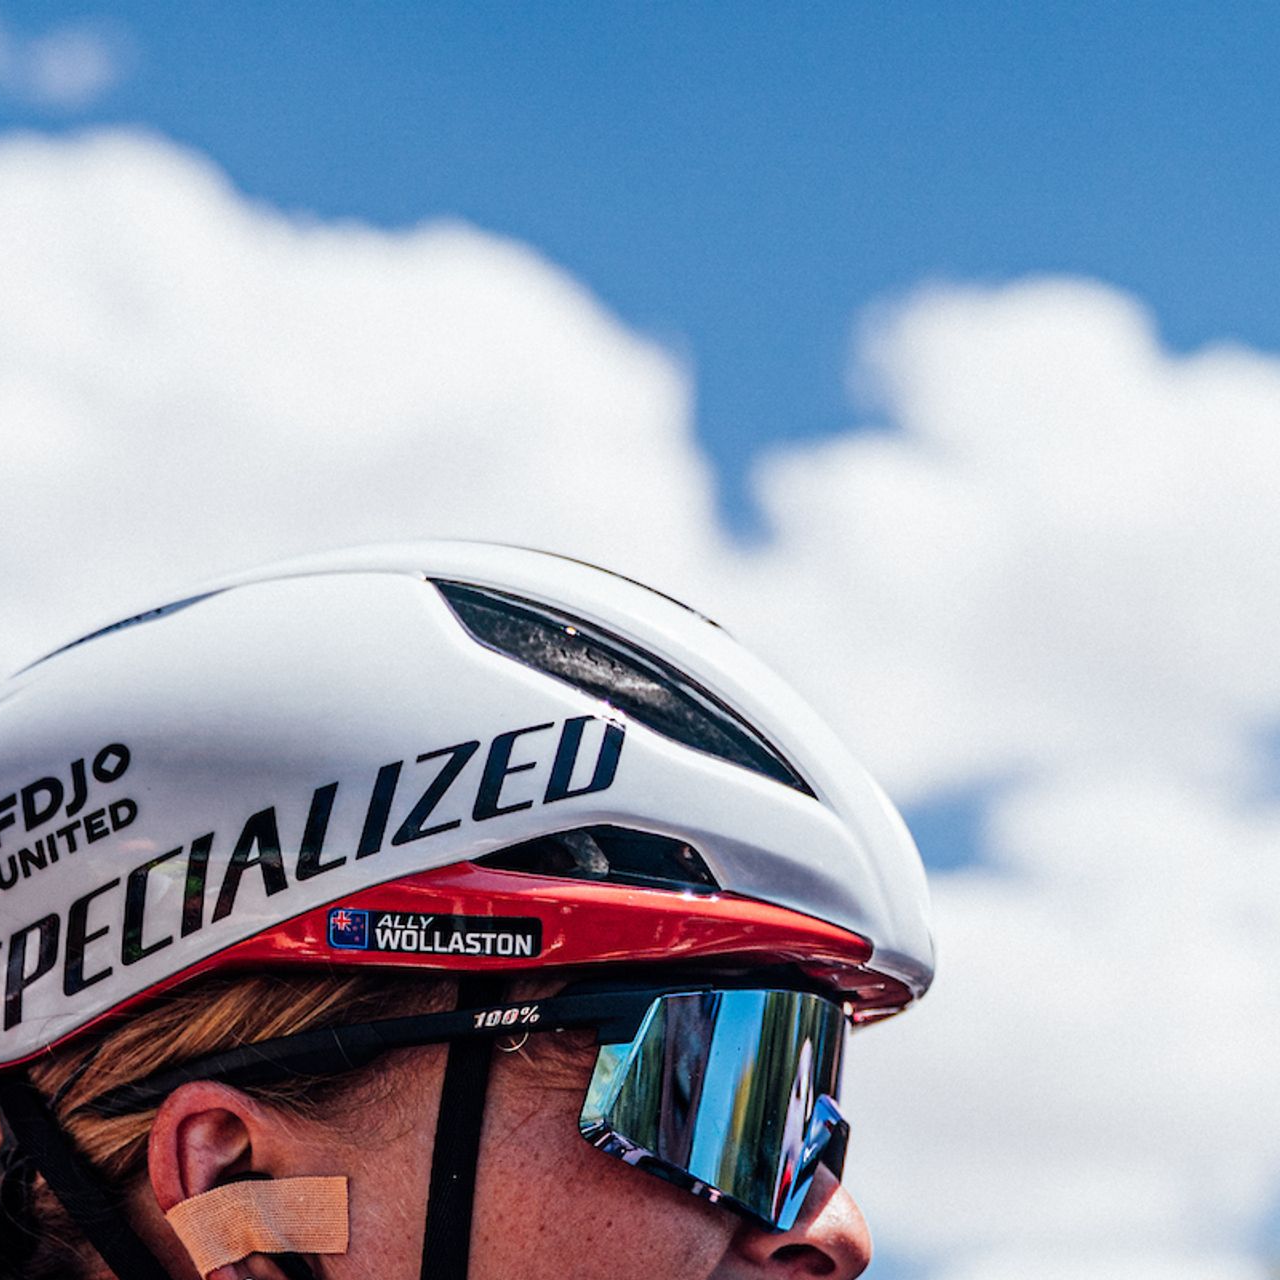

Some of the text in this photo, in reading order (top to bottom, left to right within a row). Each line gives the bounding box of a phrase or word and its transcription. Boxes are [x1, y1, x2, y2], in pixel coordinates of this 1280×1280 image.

[377, 914, 434, 929] ALLY
[375, 928, 532, 956] WOLLASTON
[474, 1005, 540, 1029] 100%
